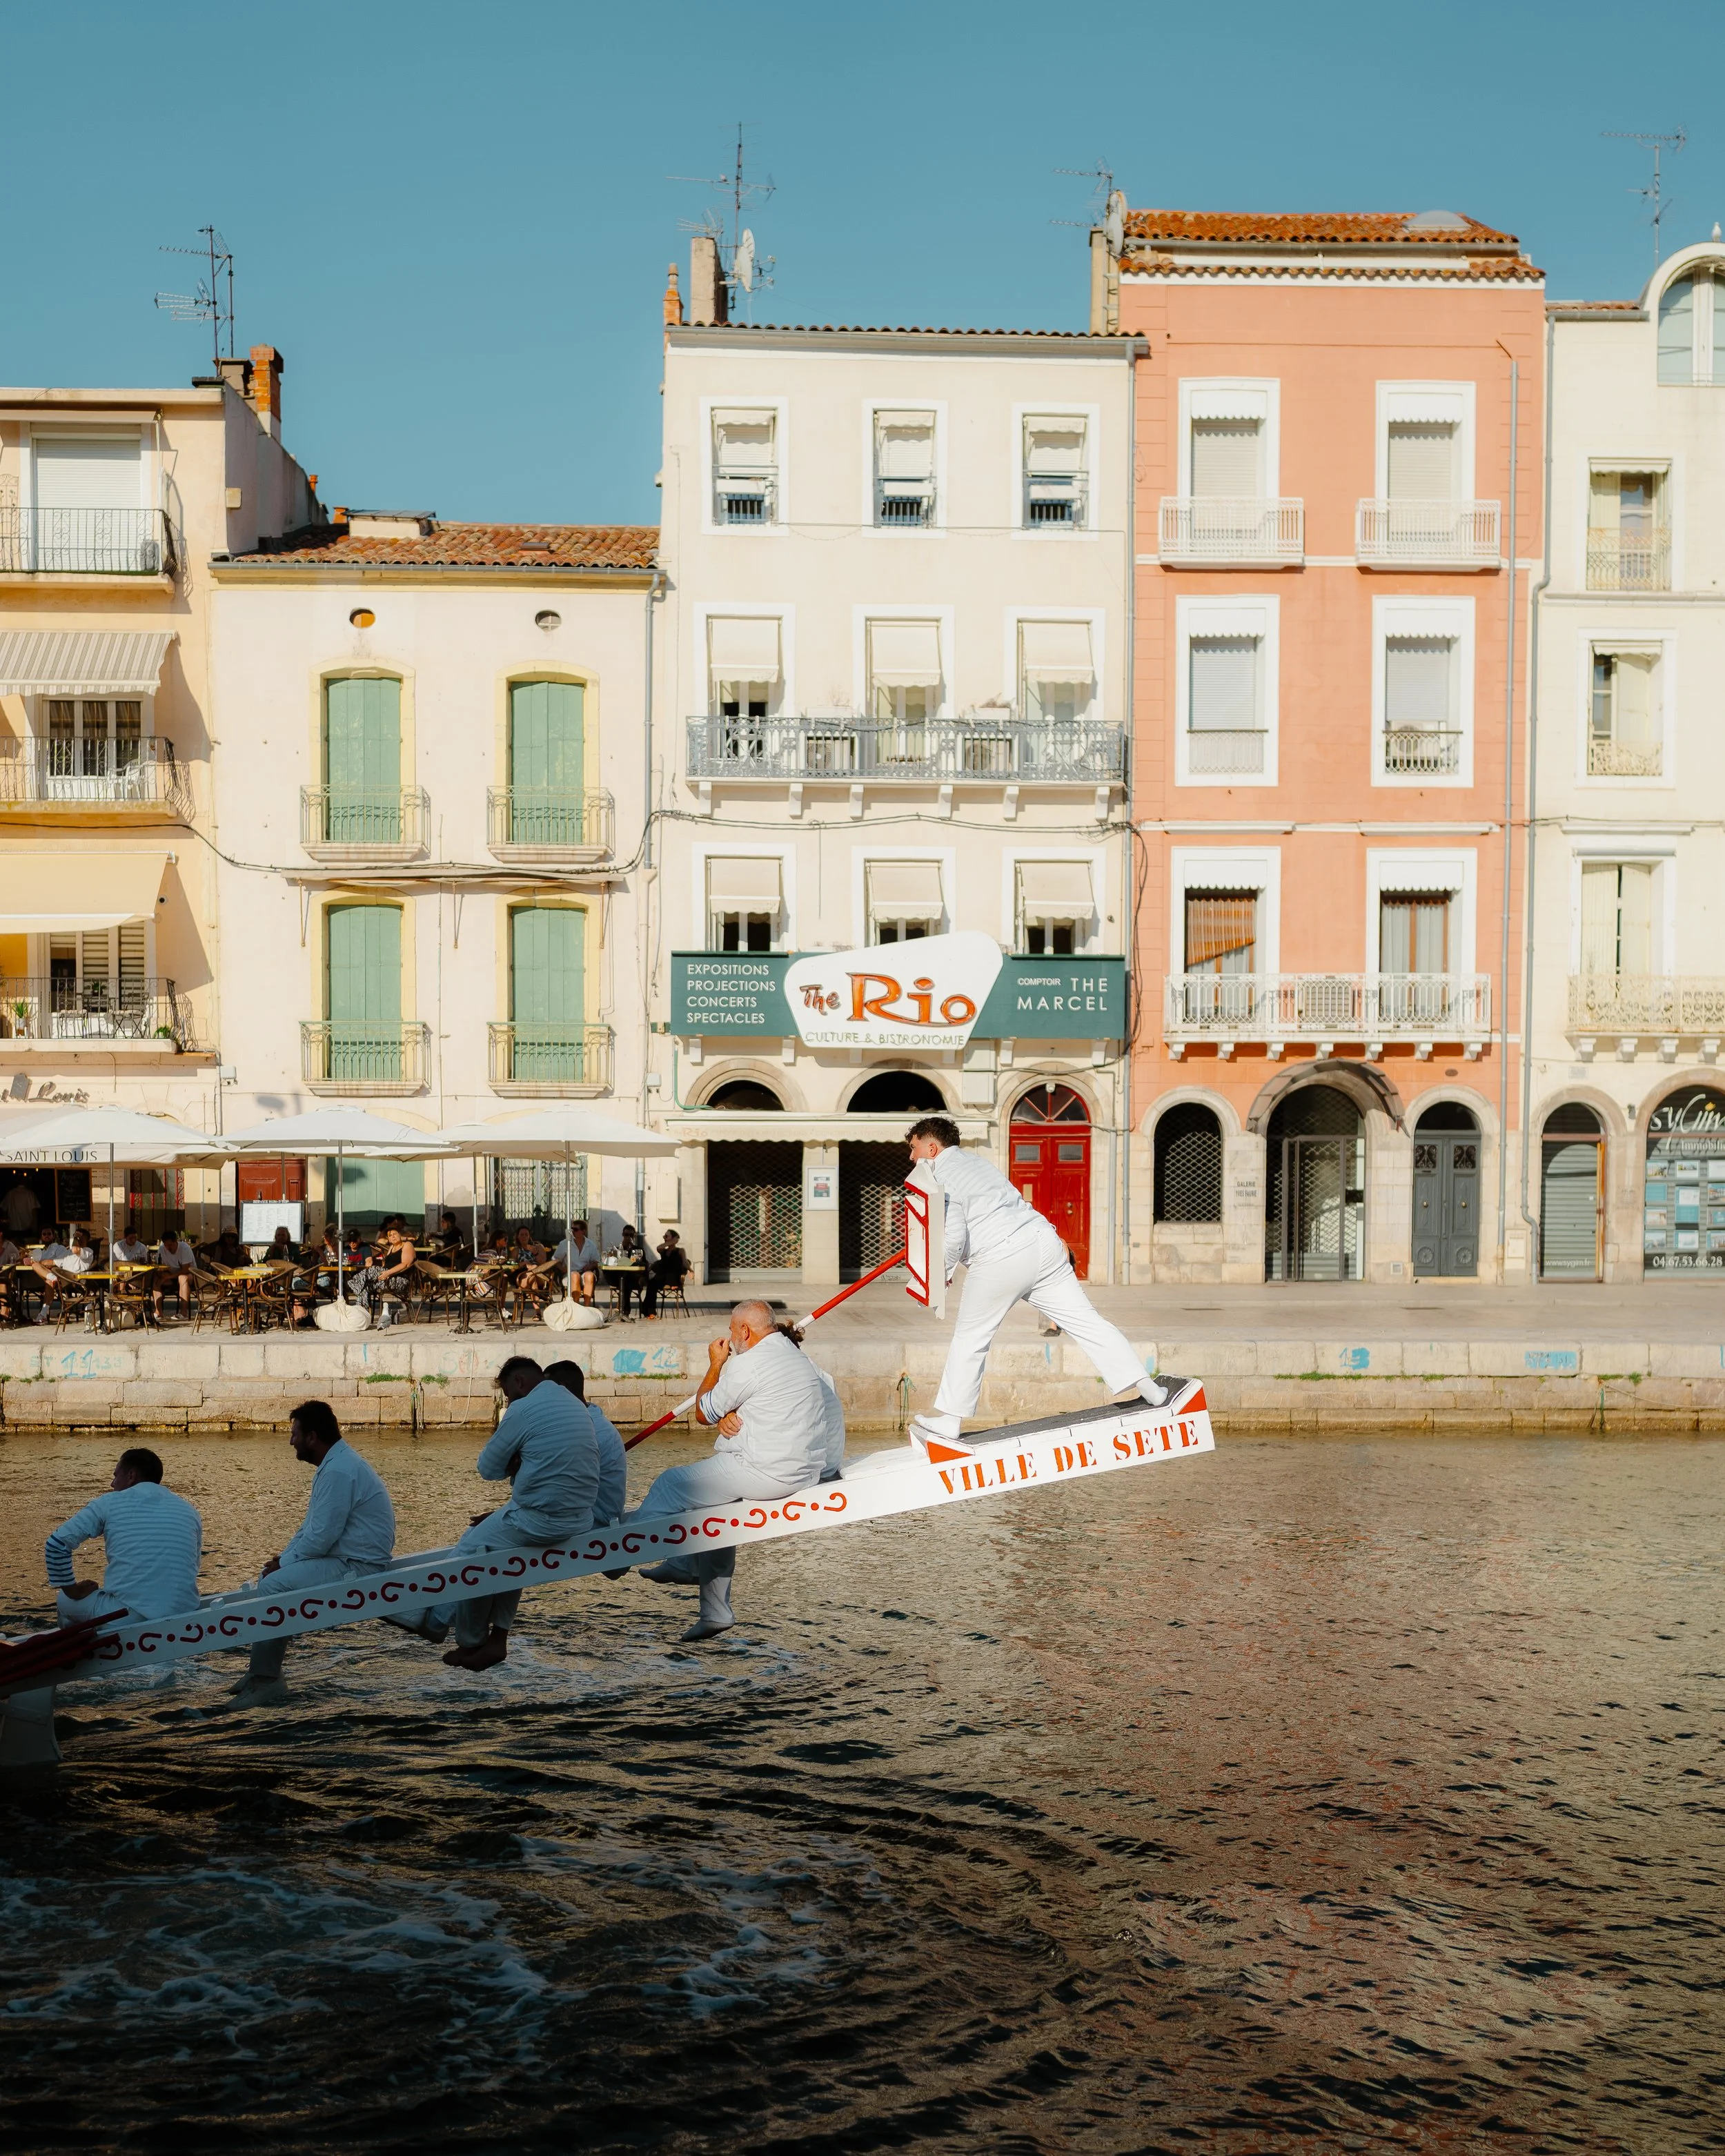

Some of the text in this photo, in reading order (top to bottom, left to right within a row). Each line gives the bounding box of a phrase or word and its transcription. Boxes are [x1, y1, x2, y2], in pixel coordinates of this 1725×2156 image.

[687, 964, 769, 975] EXPOSITIONS
[687, 980, 776, 991] PROJECTIONS
[1017, 978, 1108, 992] COMPTOIR THE
[687, 996, 758, 1007] CONCERTS
[799, 972, 978, 1027] The Rio
[1017, 996, 1107, 1011] MARCEL
[687, 1012, 765, 1024] SPECTACLES
[805, 1031, 965, 1046] CULTURE & BISTRONOMIE
[5, 1150, 98, 1162] SAINT LOUIS
[938, 1420, 1199, 1494] VILLE DE SETE
